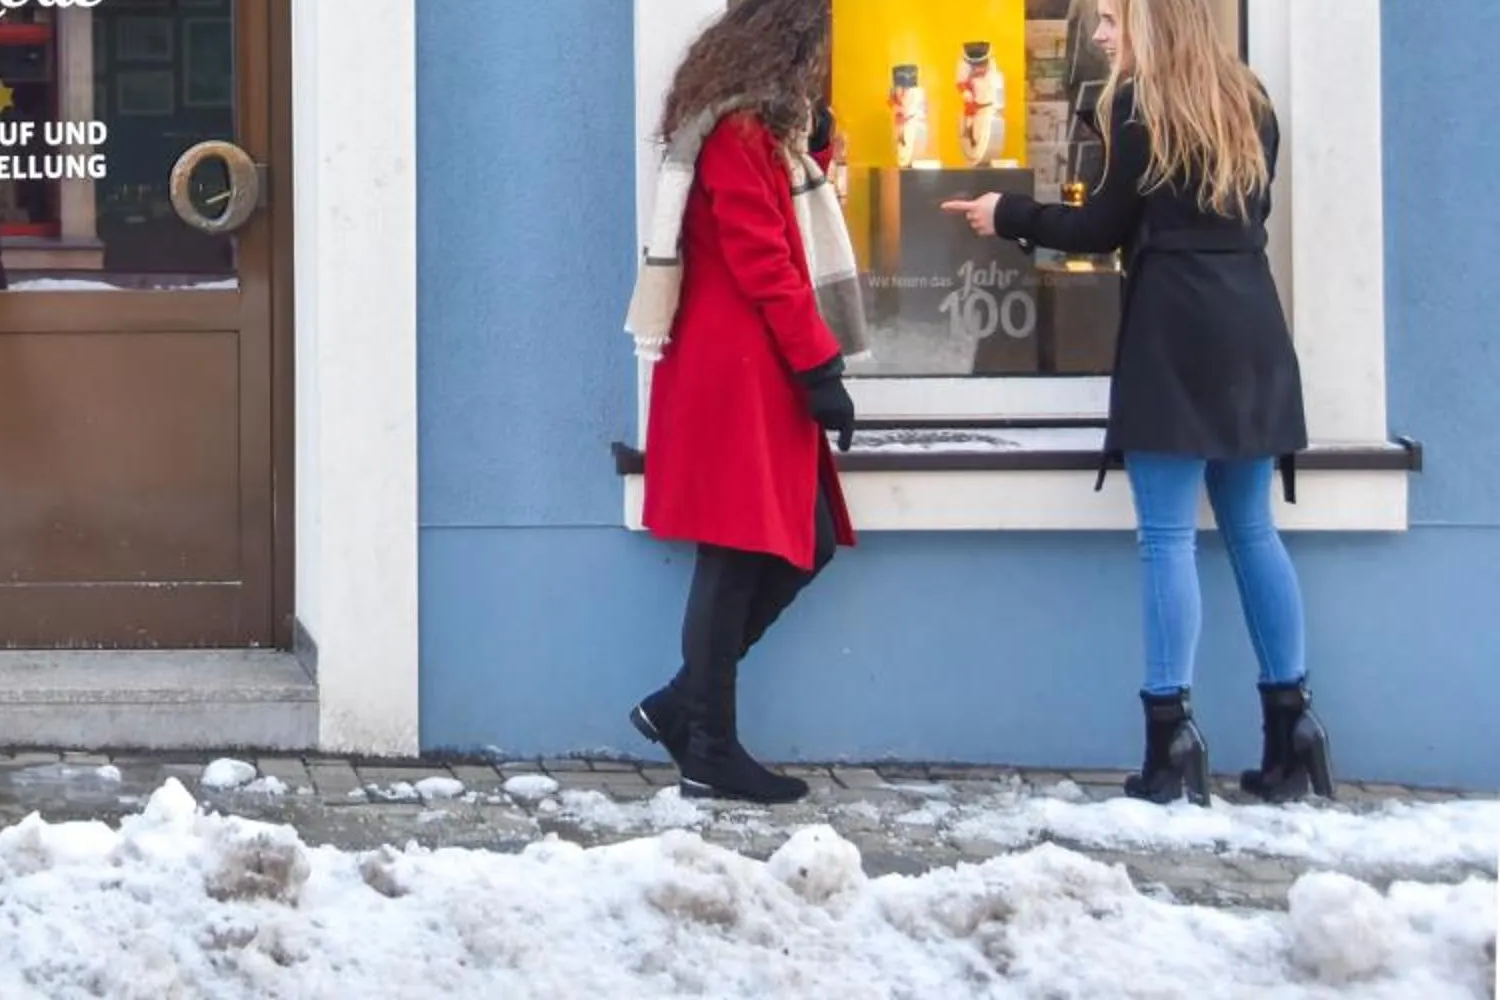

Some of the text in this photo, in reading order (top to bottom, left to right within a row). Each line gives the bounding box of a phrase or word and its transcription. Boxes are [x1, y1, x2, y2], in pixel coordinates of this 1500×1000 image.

[45, 120, 107, 145] UND
[957, 259, 1019, 300] Jahr
[938, 290, 1037, 340] 100
